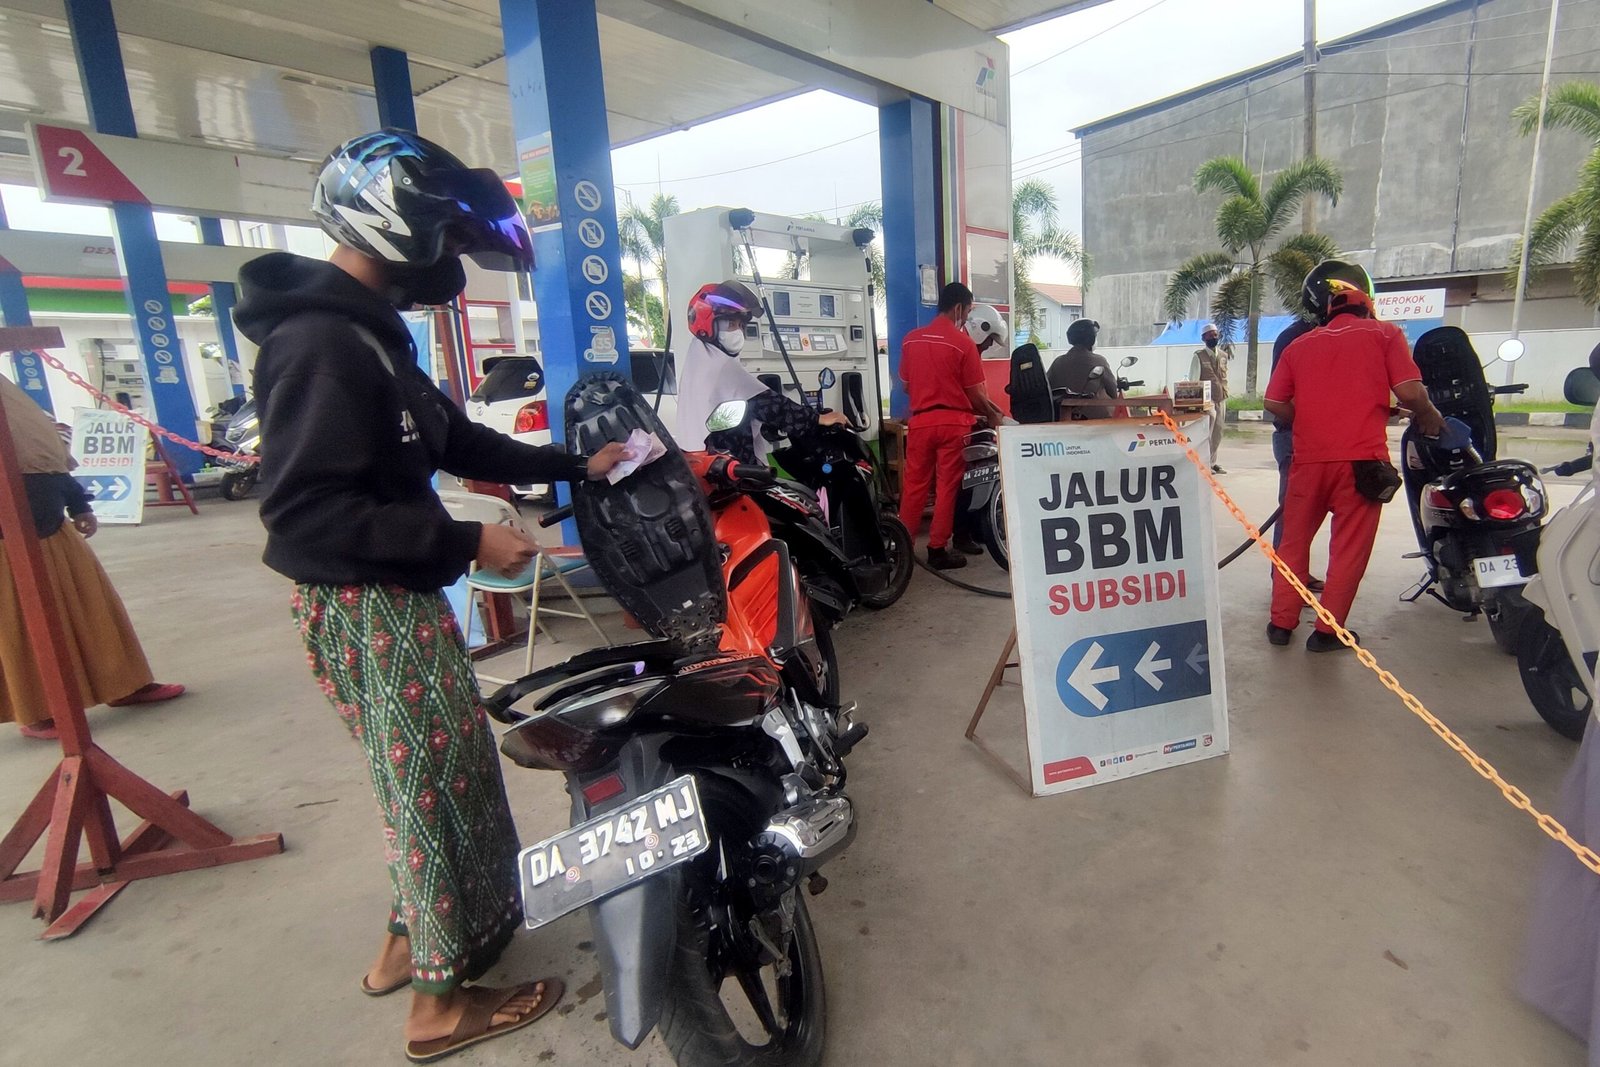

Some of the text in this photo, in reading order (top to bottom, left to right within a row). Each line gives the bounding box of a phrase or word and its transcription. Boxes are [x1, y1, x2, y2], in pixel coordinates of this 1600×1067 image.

[58, 146, 87, 177] 2
[1378, 295, 1425, 305] MEROKOK
[86, 422, 136, 435] JALUR
[83, 436, 135, 455] BBM
[82, 456, 134, 468] SUBSIDI
[1038, 464, 1179, 512] JALUR
[1040, 505, 1184, 576] BBM
[1479, 561, 1496, 573] DA
[1049, 569, 1187, 616] SUBSIDI
[531, 785, 696, 887] DA 3742 MJ
